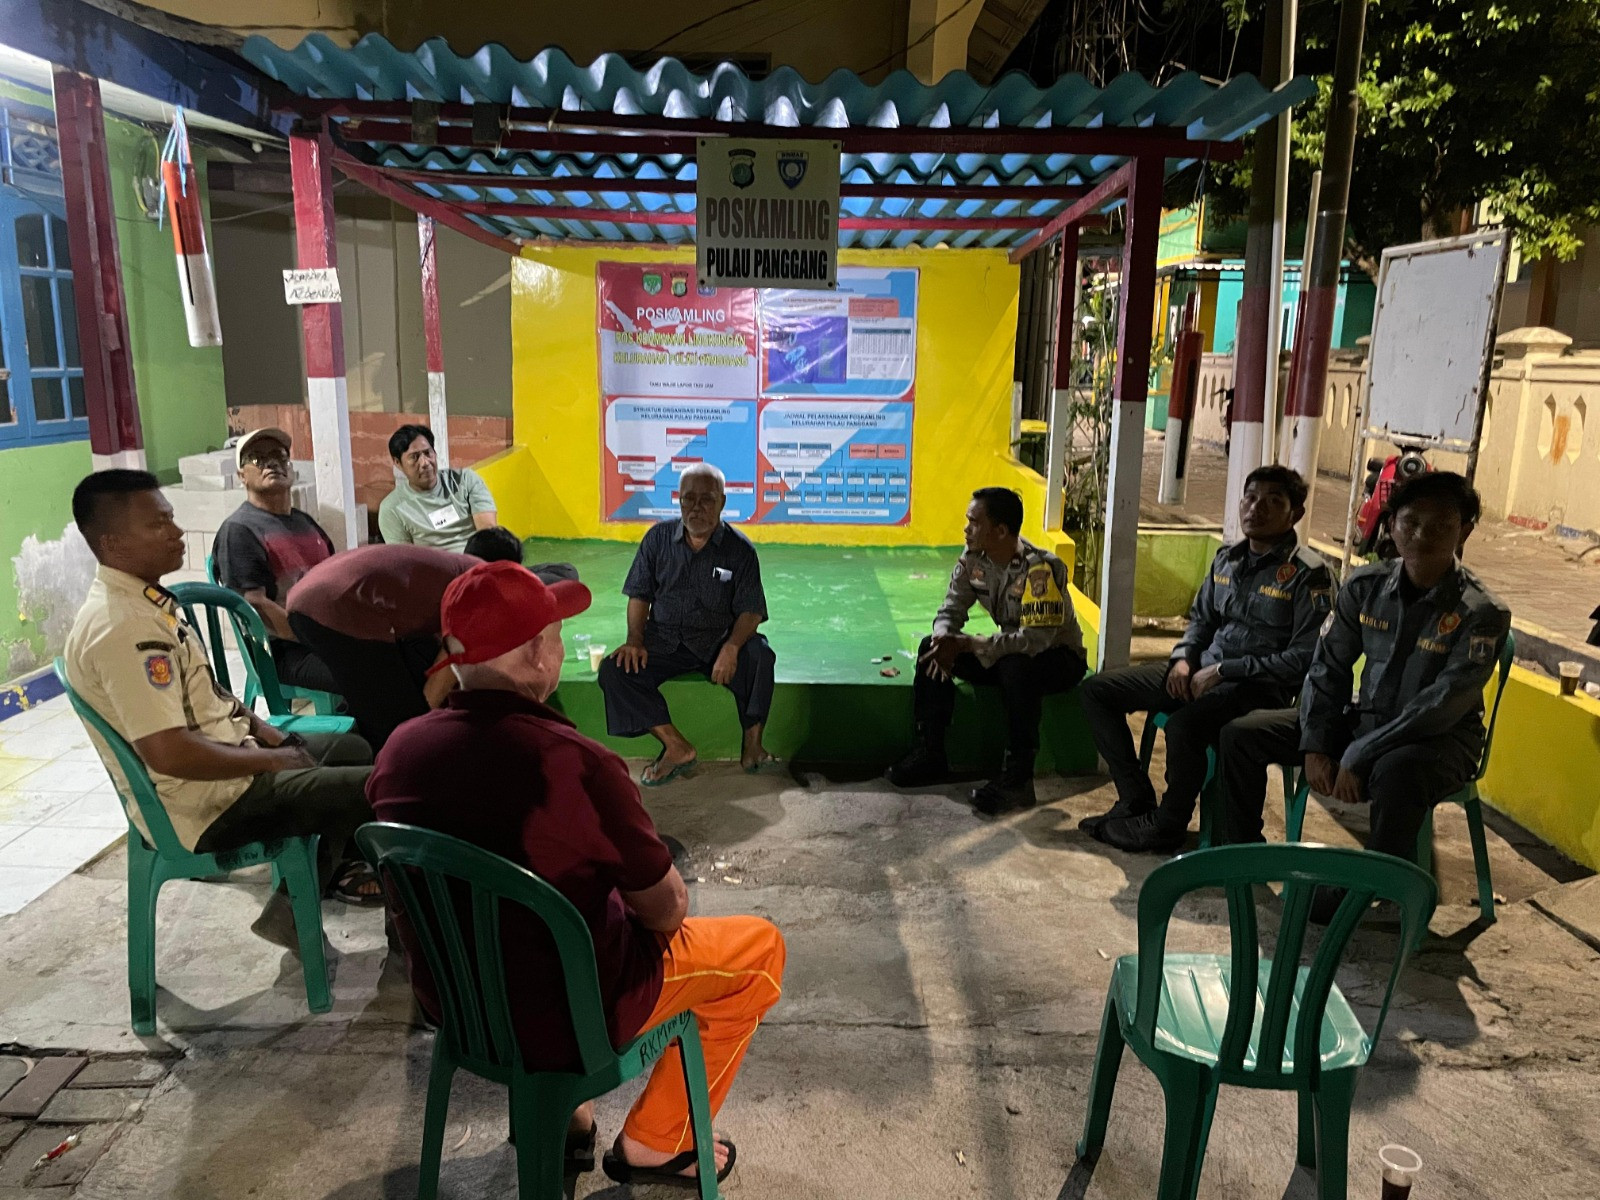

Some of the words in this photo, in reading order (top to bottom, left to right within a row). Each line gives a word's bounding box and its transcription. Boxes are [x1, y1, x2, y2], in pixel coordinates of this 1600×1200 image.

[705, 197, 830, 240] POSKAMLING
[707, 248, 750, 278] PULAU
[754, 248, 828, 280] PANGGANG
[636, 306, 726, 322] POSKAMLING
[614, 331, 633, 345] POS
[688, 332, 746, 347] LINGKUNGAN
[613, 351, 668, 365] KELURAHAN
